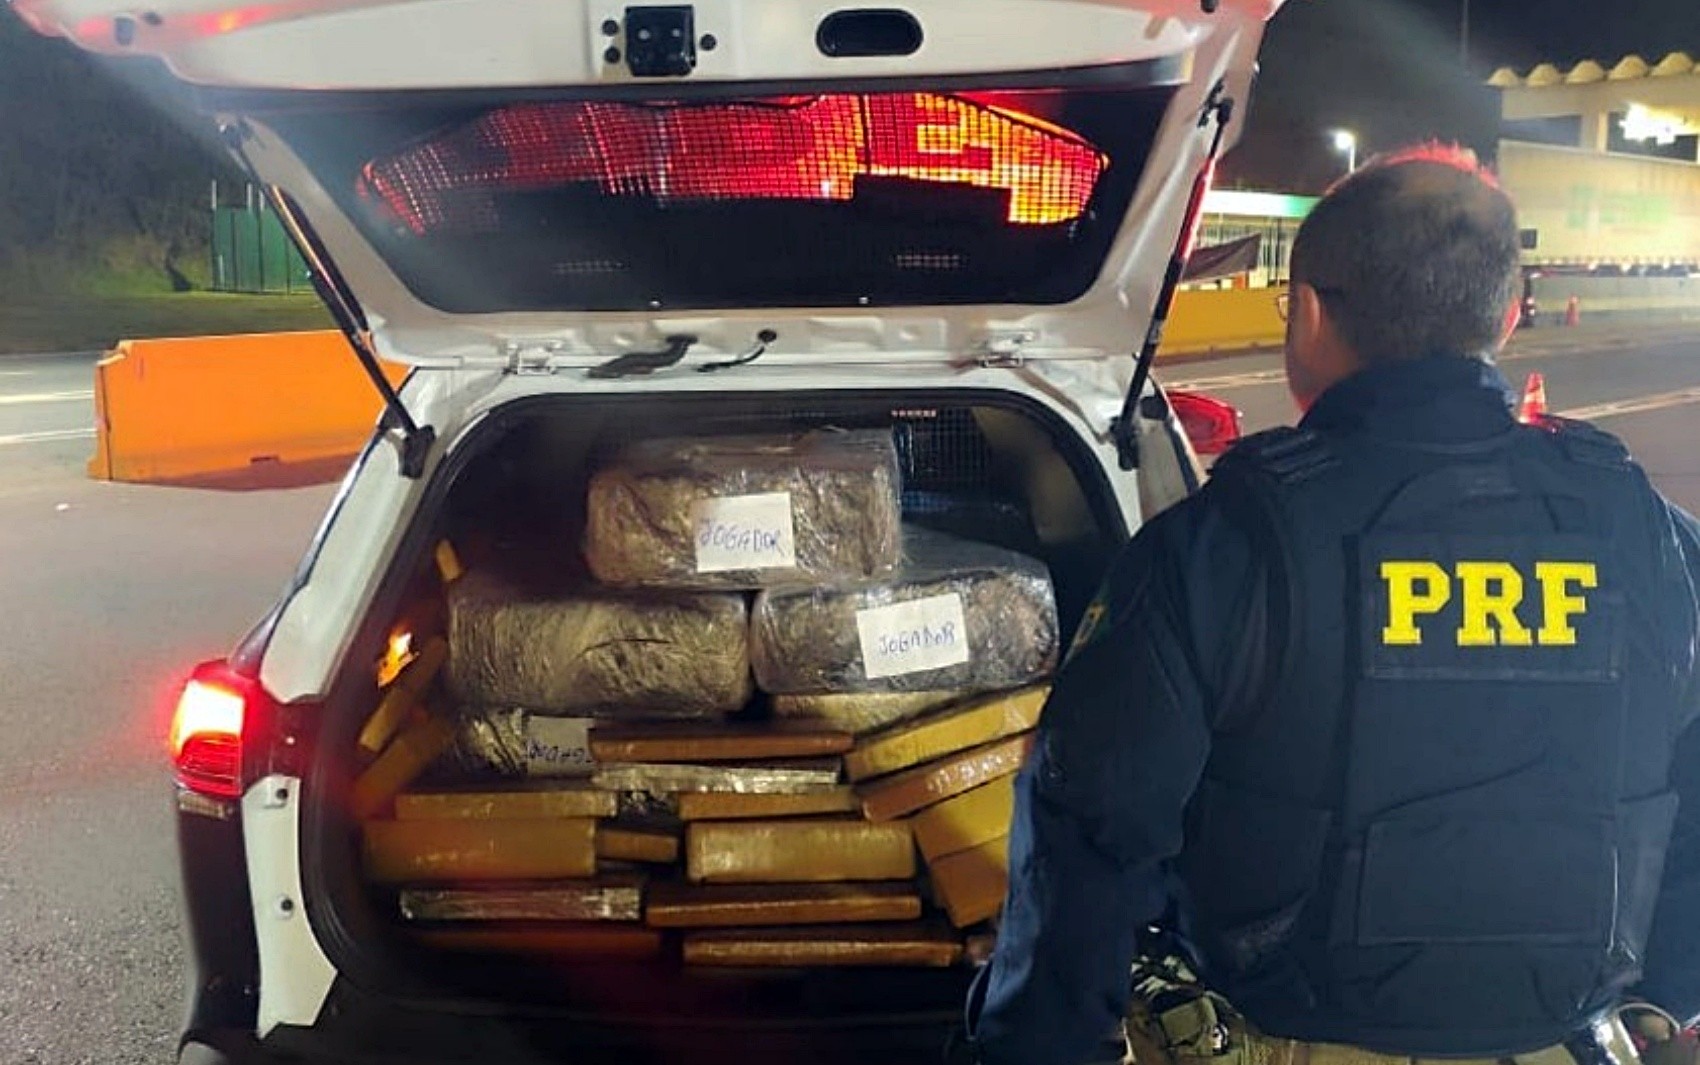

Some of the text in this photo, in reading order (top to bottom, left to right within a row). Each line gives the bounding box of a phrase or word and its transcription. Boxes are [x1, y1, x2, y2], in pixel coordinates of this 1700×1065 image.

[699, 519, 786, 558] JOGADOR
[1380, 561, 1598, 646] PRF
[878, 619, 955, 656] JOGADOR
